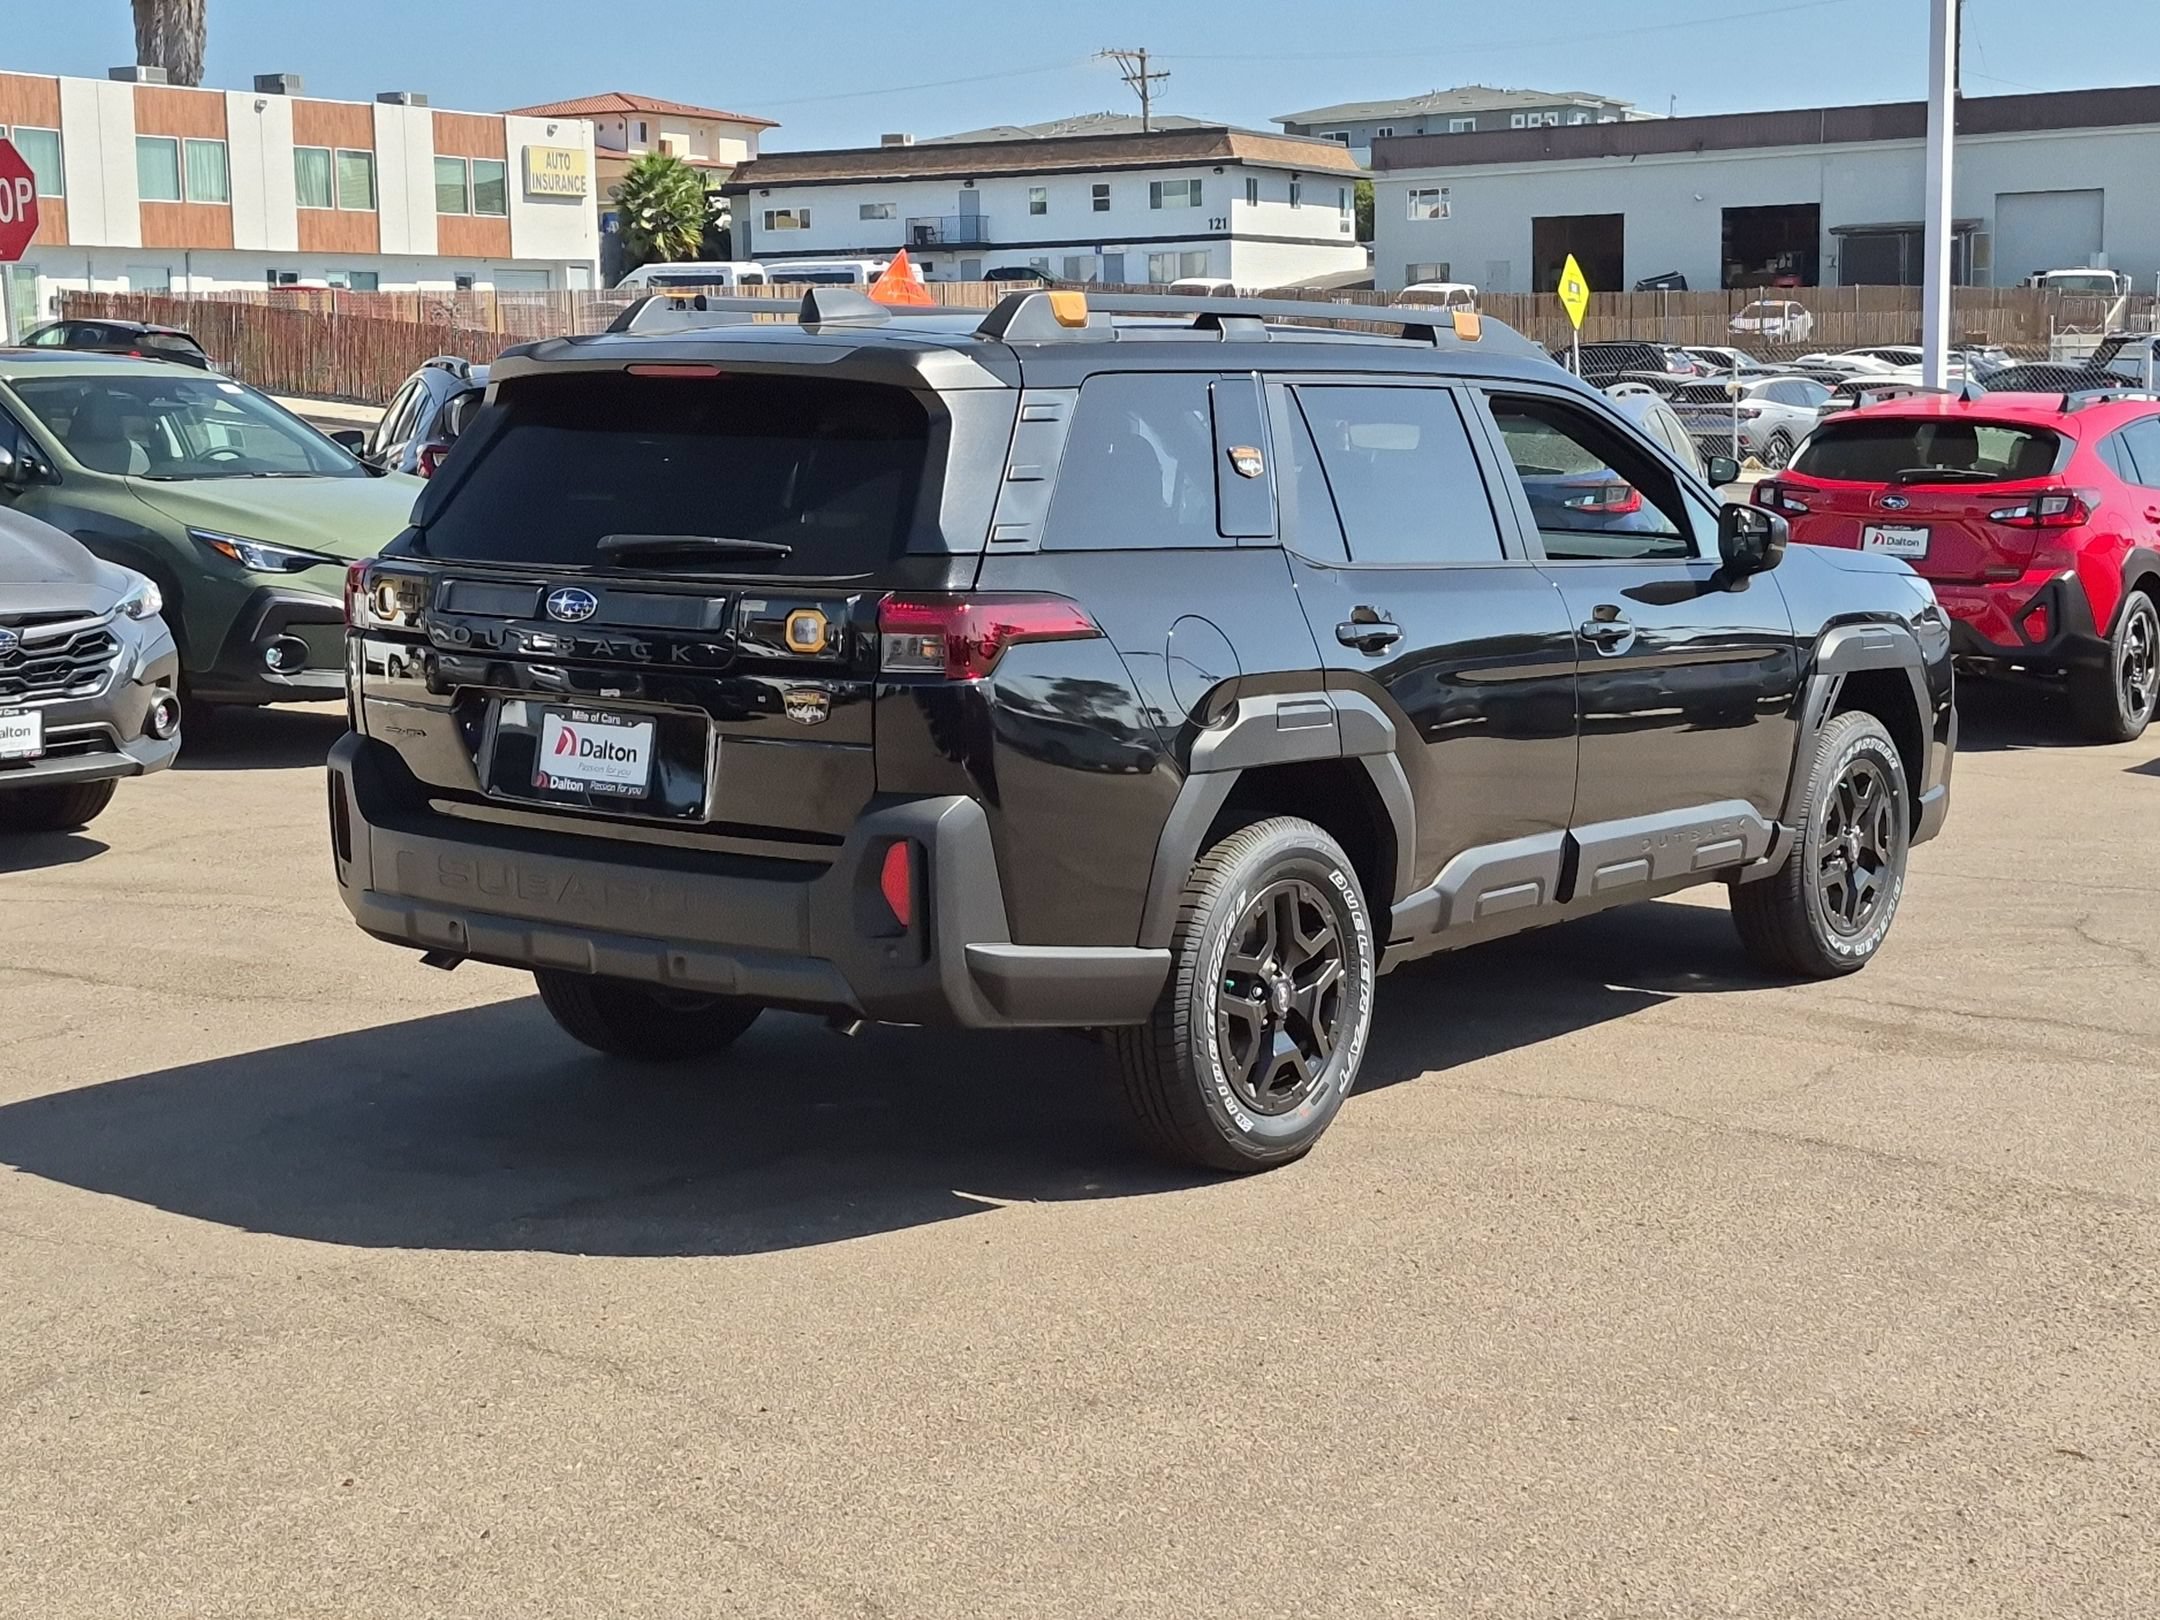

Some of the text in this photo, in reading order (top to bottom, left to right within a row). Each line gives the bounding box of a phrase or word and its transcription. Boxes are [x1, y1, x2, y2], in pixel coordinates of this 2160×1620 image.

[546, 152, 571, 170] AUTO
[531, 173, 586, 192] INSURANCE
[1207, 217, 1227, 230] 121
[1886, 537, 1919, 546] Dalton
[572, 710, 621, 725] Mile of Cars
[580, 738, 637, 763] Dalton
[578, 762, 632, 777] Passion for you
[549, 776, 584, 792] Dalton
[589, 781, 643, 795] Passion for you
[1328, 868, 1371, 1016] DUELER
